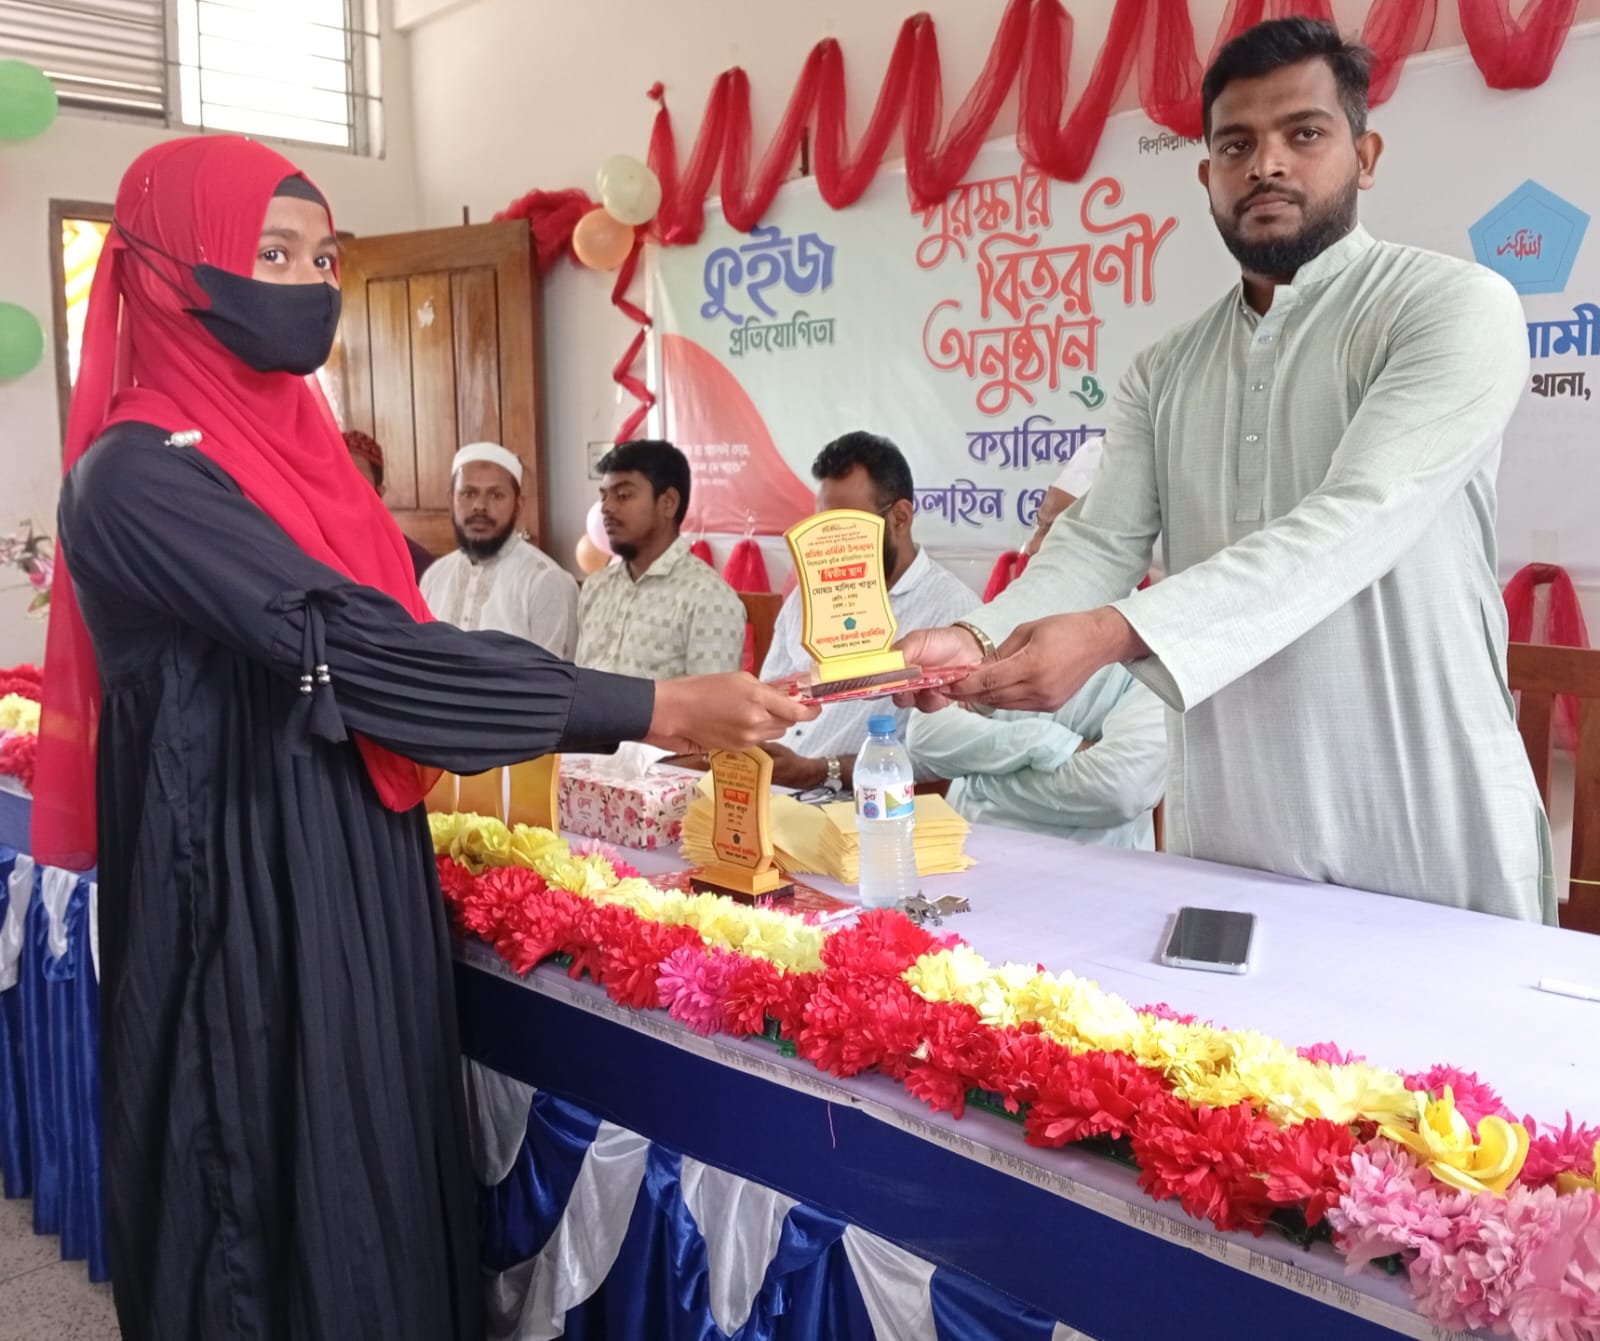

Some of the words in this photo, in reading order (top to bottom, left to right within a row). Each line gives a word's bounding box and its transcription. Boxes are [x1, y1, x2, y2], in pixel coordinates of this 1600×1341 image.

[700, 224, 836, 326] কুইজ
[975, 176, 1178, 320] বিতরণী
[728, 309, 836, 357] প্রতিযোগিতা
[923, 298, 1105, 415] অনুষ্ঠান
[1530, 371, 1592, 401] থানা,
[965, 414, 1107, 469] ক্যারিয়া
